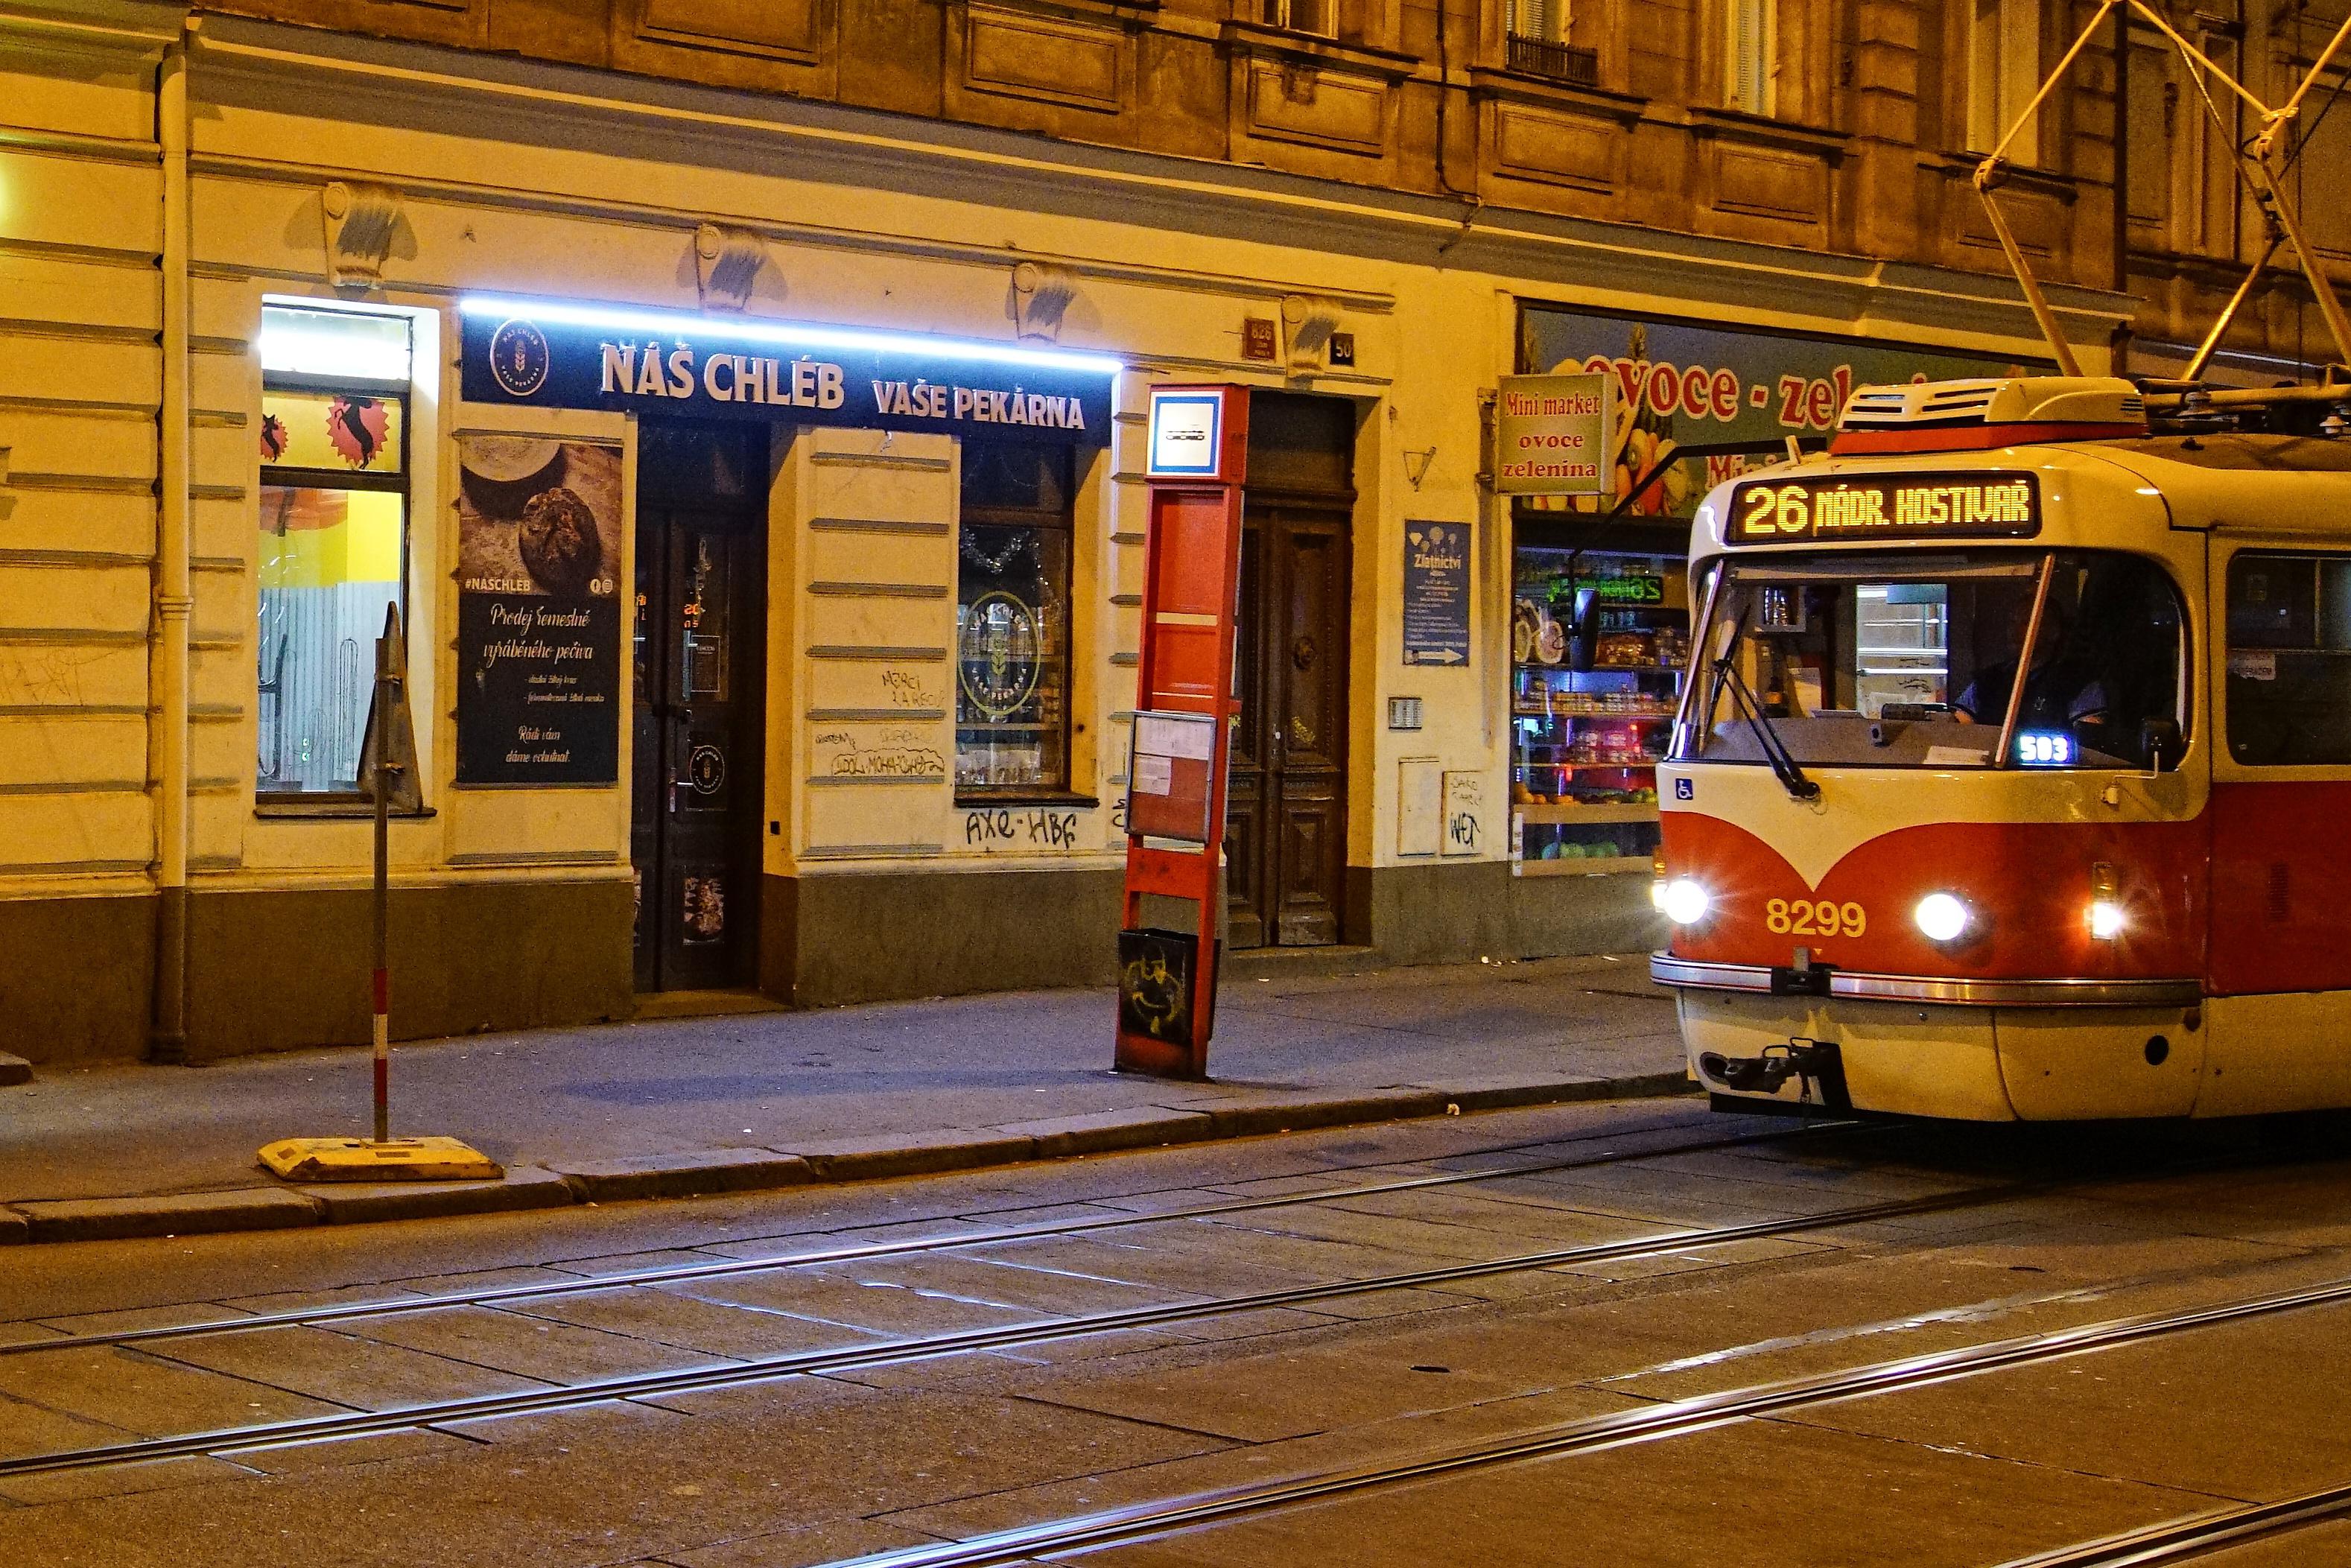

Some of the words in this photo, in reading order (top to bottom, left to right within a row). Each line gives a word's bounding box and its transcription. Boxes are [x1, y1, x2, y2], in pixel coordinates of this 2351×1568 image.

[600, 341, 694, 399] NÁŠ
[704, 354, 845, 410] CHLÉB
[871, 378, 947, 418] VAŠE
[953, 383, 1085, 430] PEKÁRNA
[1506, 393, 1539, 416] Mini
[1543, 393, 1599, 416] market
[1519, 434, 1584, 449] ovoce
[1745, 486, 1809, 534] 26
[465, 579, 531, 591] #NASCHLEB
[490, 603, 533, 636] Prodej
[2020, 736, 2068, 761] 503
[1766, 898, 1867, 938] 8299
